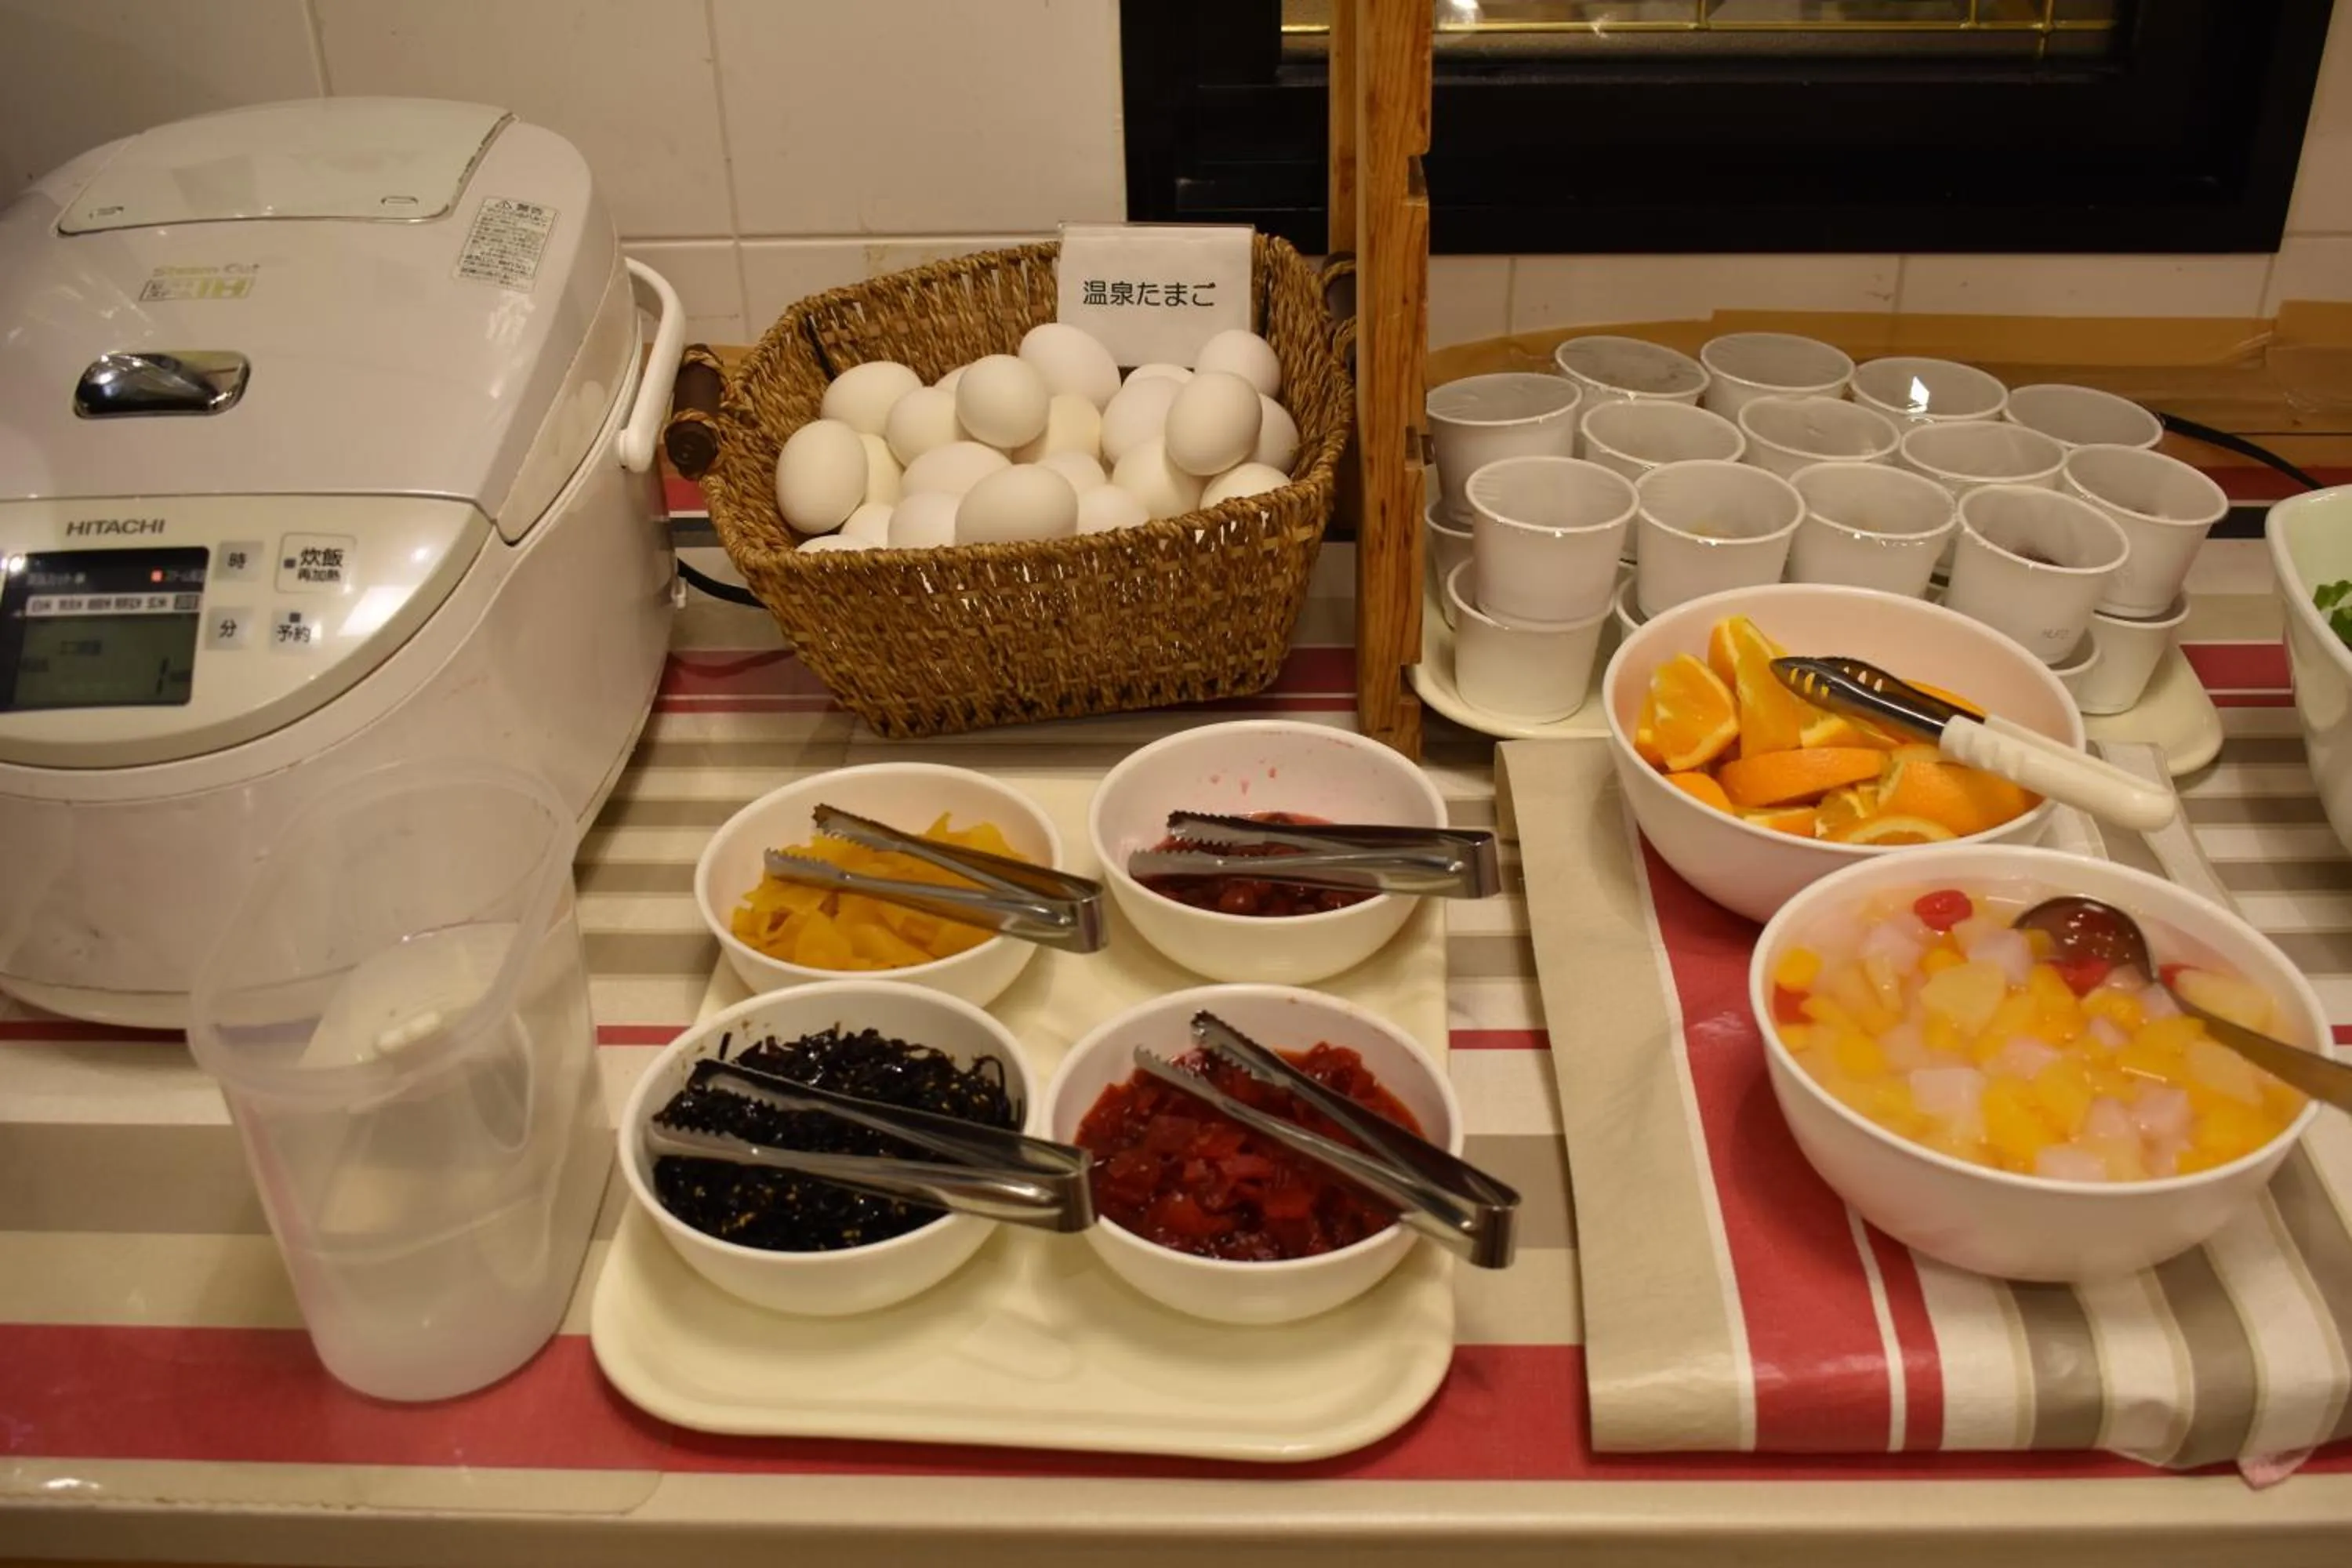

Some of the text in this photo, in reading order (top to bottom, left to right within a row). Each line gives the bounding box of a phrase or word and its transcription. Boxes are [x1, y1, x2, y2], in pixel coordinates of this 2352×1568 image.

[1083, 280, 1217, 307] 温泉たまご
[66, 518, 166, 537] HITACHI
[227, 552, 247, 570] 時
[300, 547, 344, 567] 炊飯
[219, 618, 238, 638] 分
[277, 624, 311, 643] 予約
